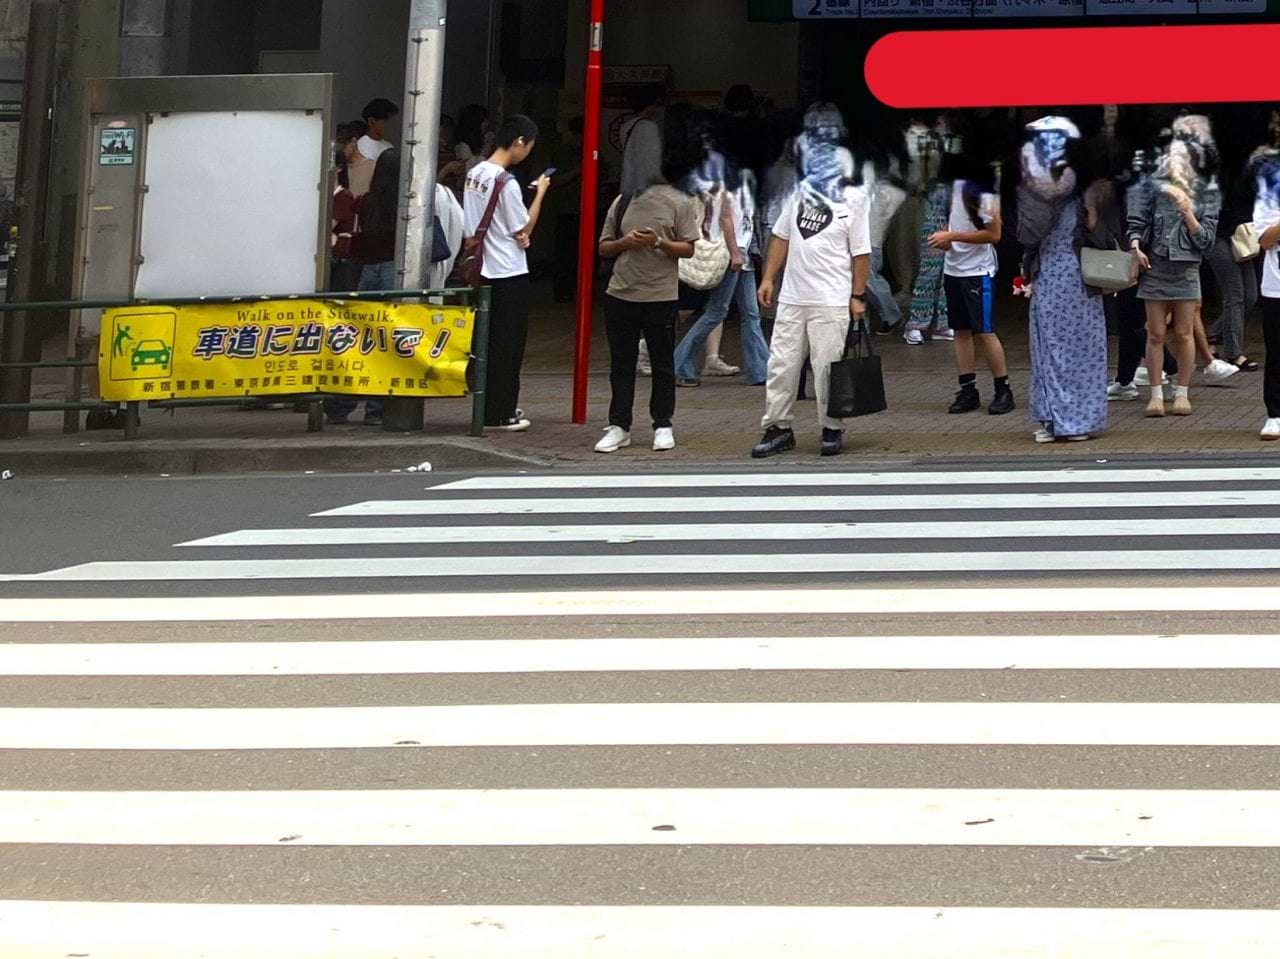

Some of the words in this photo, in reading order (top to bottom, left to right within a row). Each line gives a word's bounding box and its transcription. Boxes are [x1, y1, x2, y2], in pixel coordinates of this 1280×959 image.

[237, 309, 271, 323] Walk
[276, 311, 294, 321] on
[300, 309, 323, 321] the
[327, 308, 394, 324] Sidewalk.
[265, 359, 299, 372] 인도로
